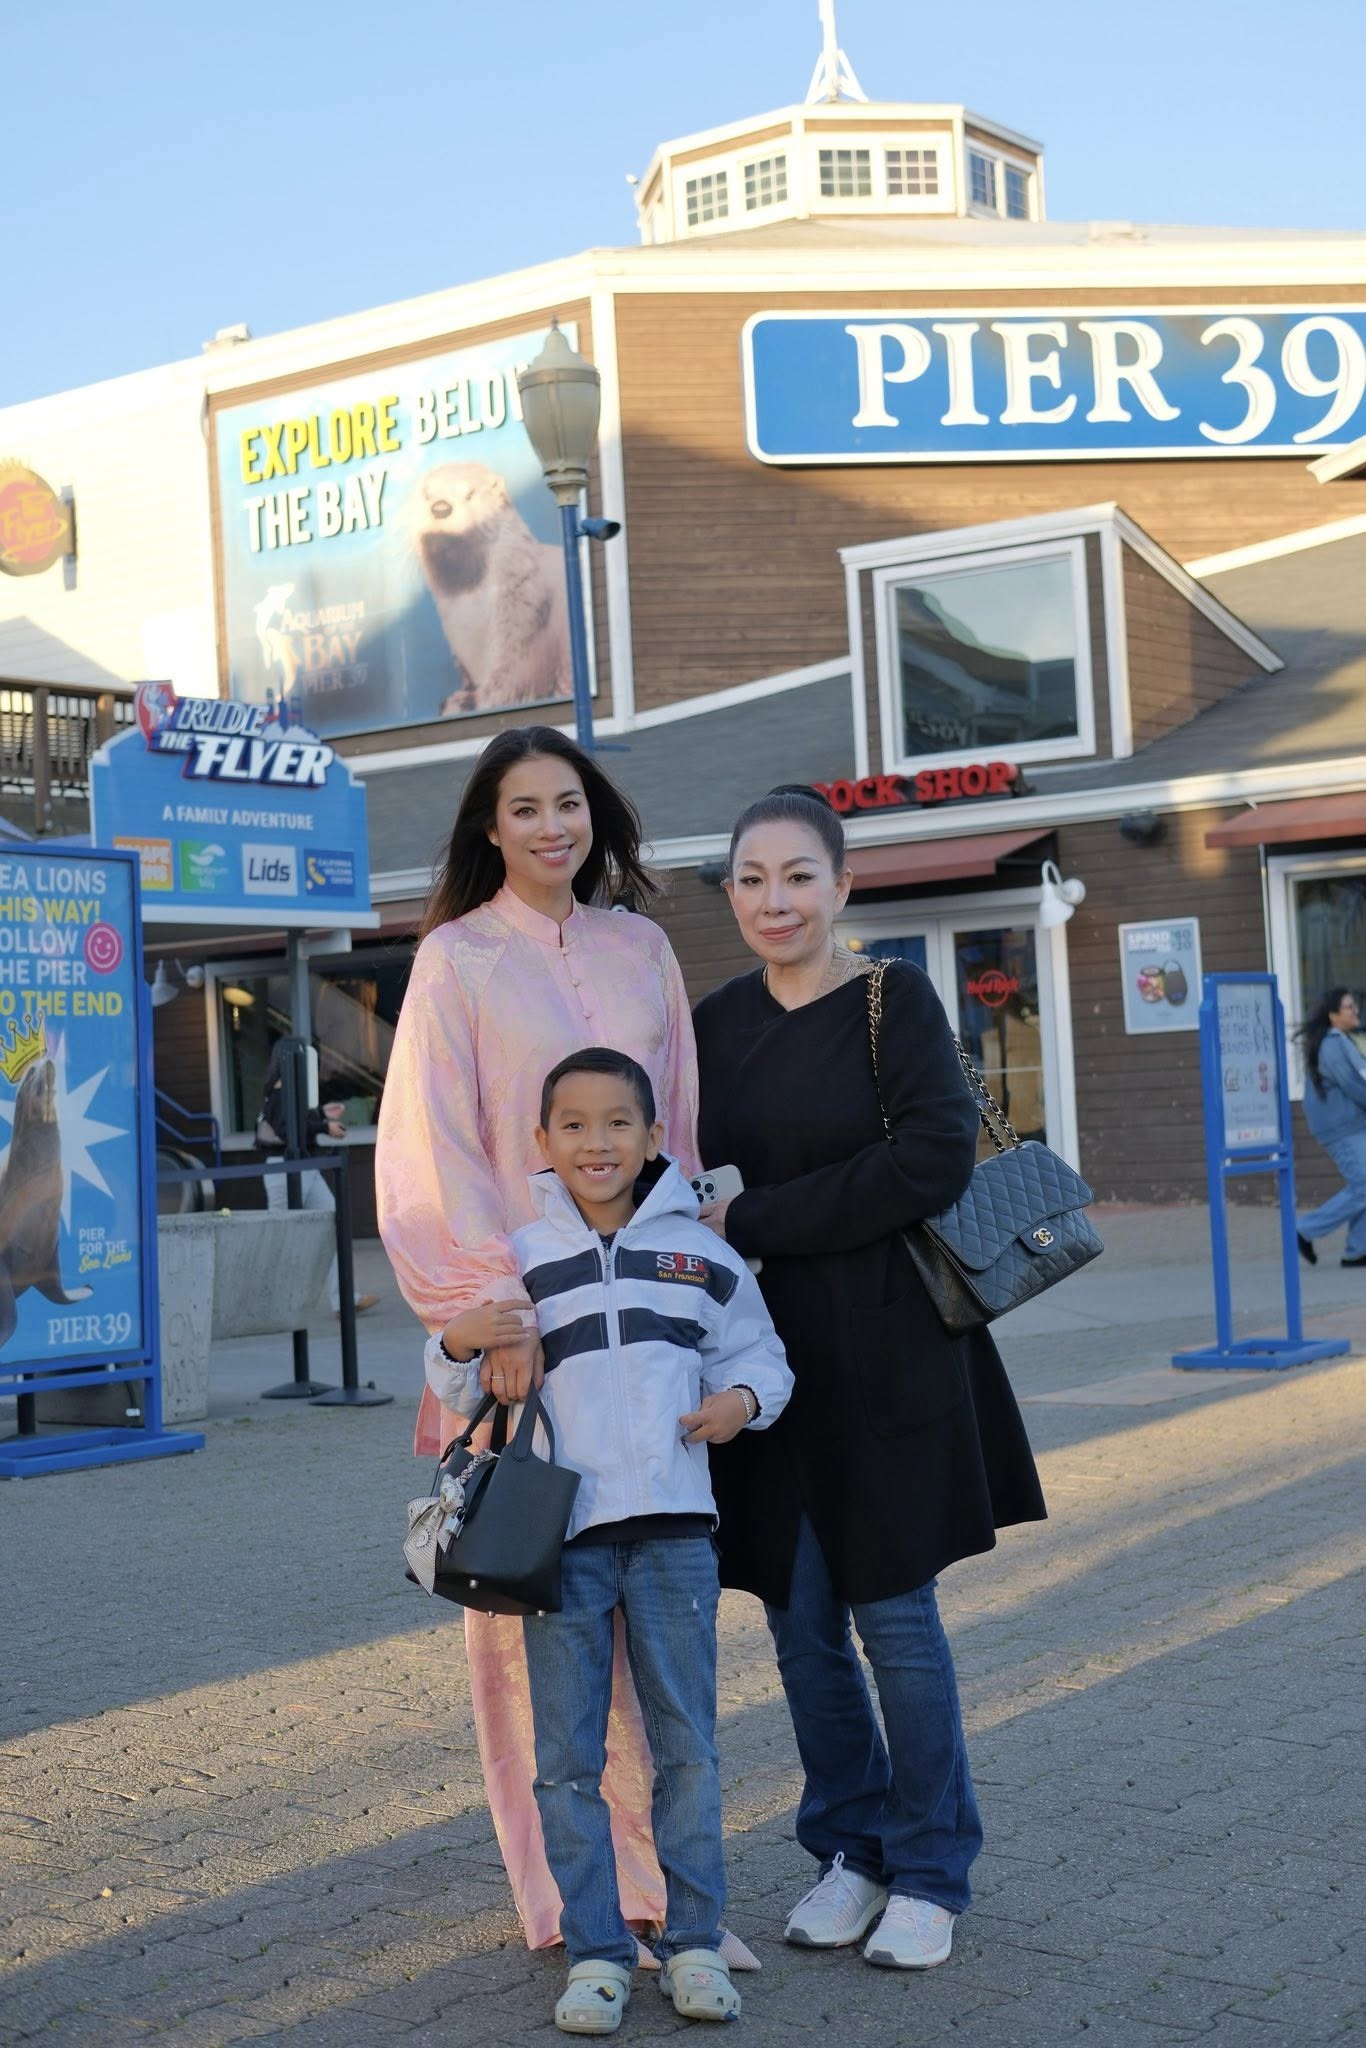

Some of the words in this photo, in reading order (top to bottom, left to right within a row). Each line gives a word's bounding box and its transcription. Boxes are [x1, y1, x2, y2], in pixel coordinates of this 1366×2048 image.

[845, 319, 1181, 427] PIER
[1199, 315, 1366, 444] 39
[240, 395, 401, 484] EXPLORE
[244, 486, 312, 552] THE
[317, 471, 387, 538] BAY
[303, 631, 363, 672] BAY
[177, 697, 270, 737] RIDE
[159, 730, 195, 750] THE
[193, 733, 335, 785] FLYER
[811, 774, 905, 812] OCK
[915, 761, 1017, 802] SHOP
[162, 805, 174, 822] A
[177, 806, 228, 825] FAMILY
[231, 809, 315, 831] ADVENTURE
[0, 864, 29, 890] EA
[36, 866, 106, 894] LIONS
[248, 857, 291, 882] Lids
[0, 896, 38, 922] HIS
[42, 898, 100, 924] WAY!
[0, 926, 79, 955] OLLOW
[0, 959, 30, 985] HE
[37, 959, 87, 986] PIER
[0, 989, 16, 1016] O
[21, 990, 67, 1016] THE
[73, 990, 123, 1017] END
[79, 1227, 105, 1242] PIER
[79, 1241, 103, 1256] FOR
[105, 1239, 127, 1254] THE
[658, 1270, 673, 1279] San
[674, 1272, 705, 1283] Francisco
